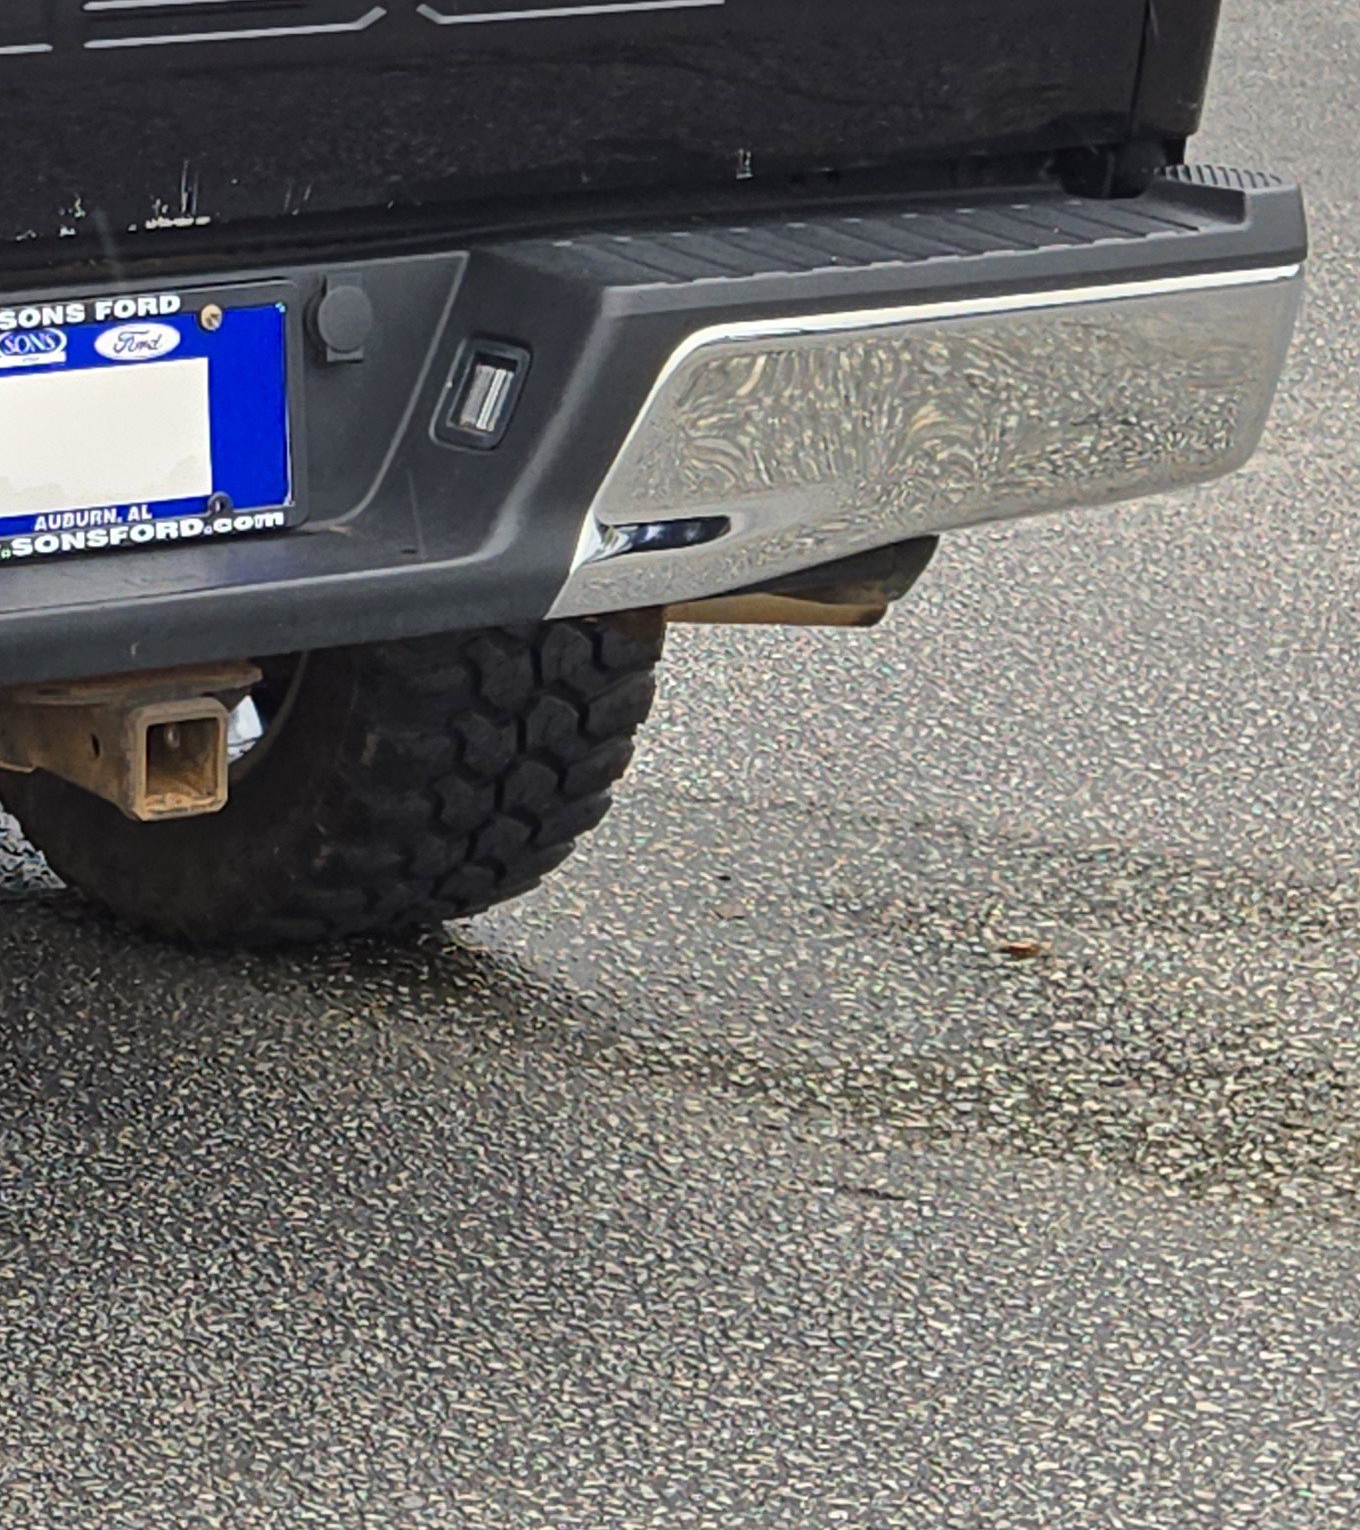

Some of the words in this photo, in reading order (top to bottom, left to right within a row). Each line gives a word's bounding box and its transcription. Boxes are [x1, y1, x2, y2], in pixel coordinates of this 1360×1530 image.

[94, 293, 181, 320] FORD
[2, 332, 57, 355] SONS
[112, 329, 164, 354] Ford
[127, 504, 153, 522] AL
